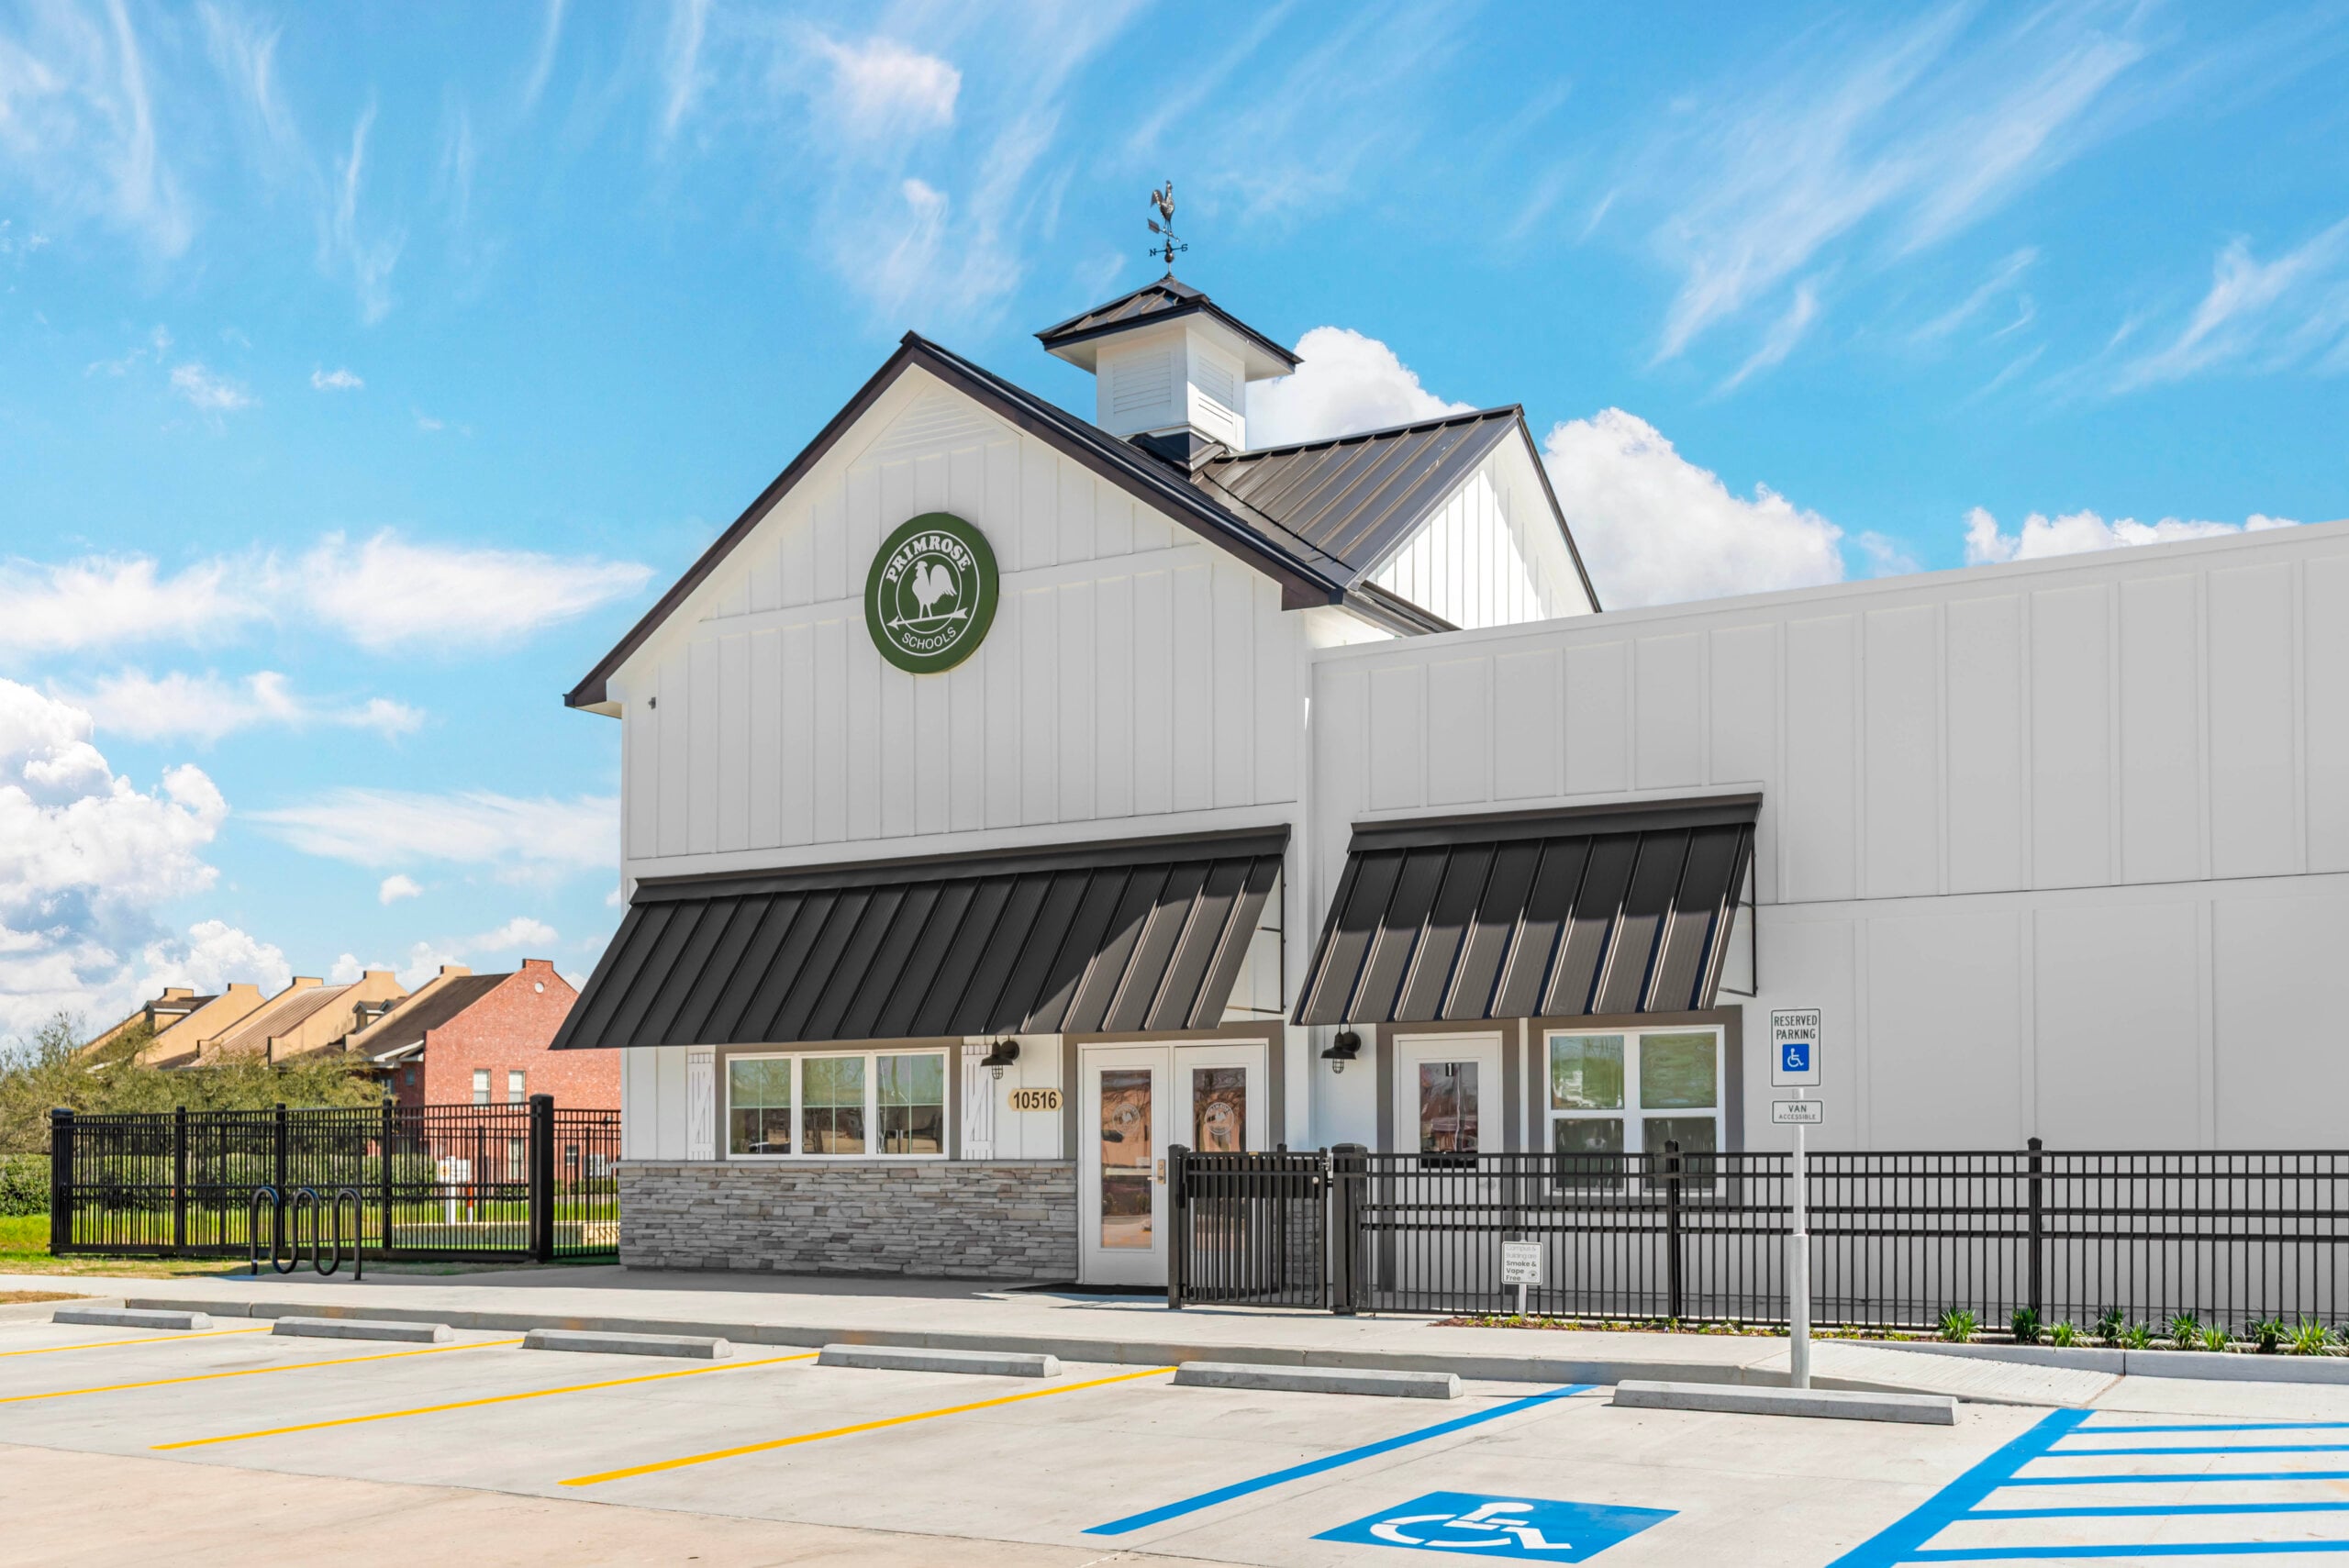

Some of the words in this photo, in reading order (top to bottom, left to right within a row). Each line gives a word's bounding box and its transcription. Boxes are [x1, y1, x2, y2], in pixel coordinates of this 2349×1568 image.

[1149, 248, 1156, 257] N
[886, 535, 972, 584] PRIMROSE
[902, 626, 957, 650] SCHOOLS
[1774, 1015, 1818, 1027] RESERVED
[1776, 1029, 1816, 1040] PARKING
[1448, 1063, 1453, 1076] 1
[1013, 1091, 1057, 1109] 10516
[1788, 1104, 1807, 1113] VAN
